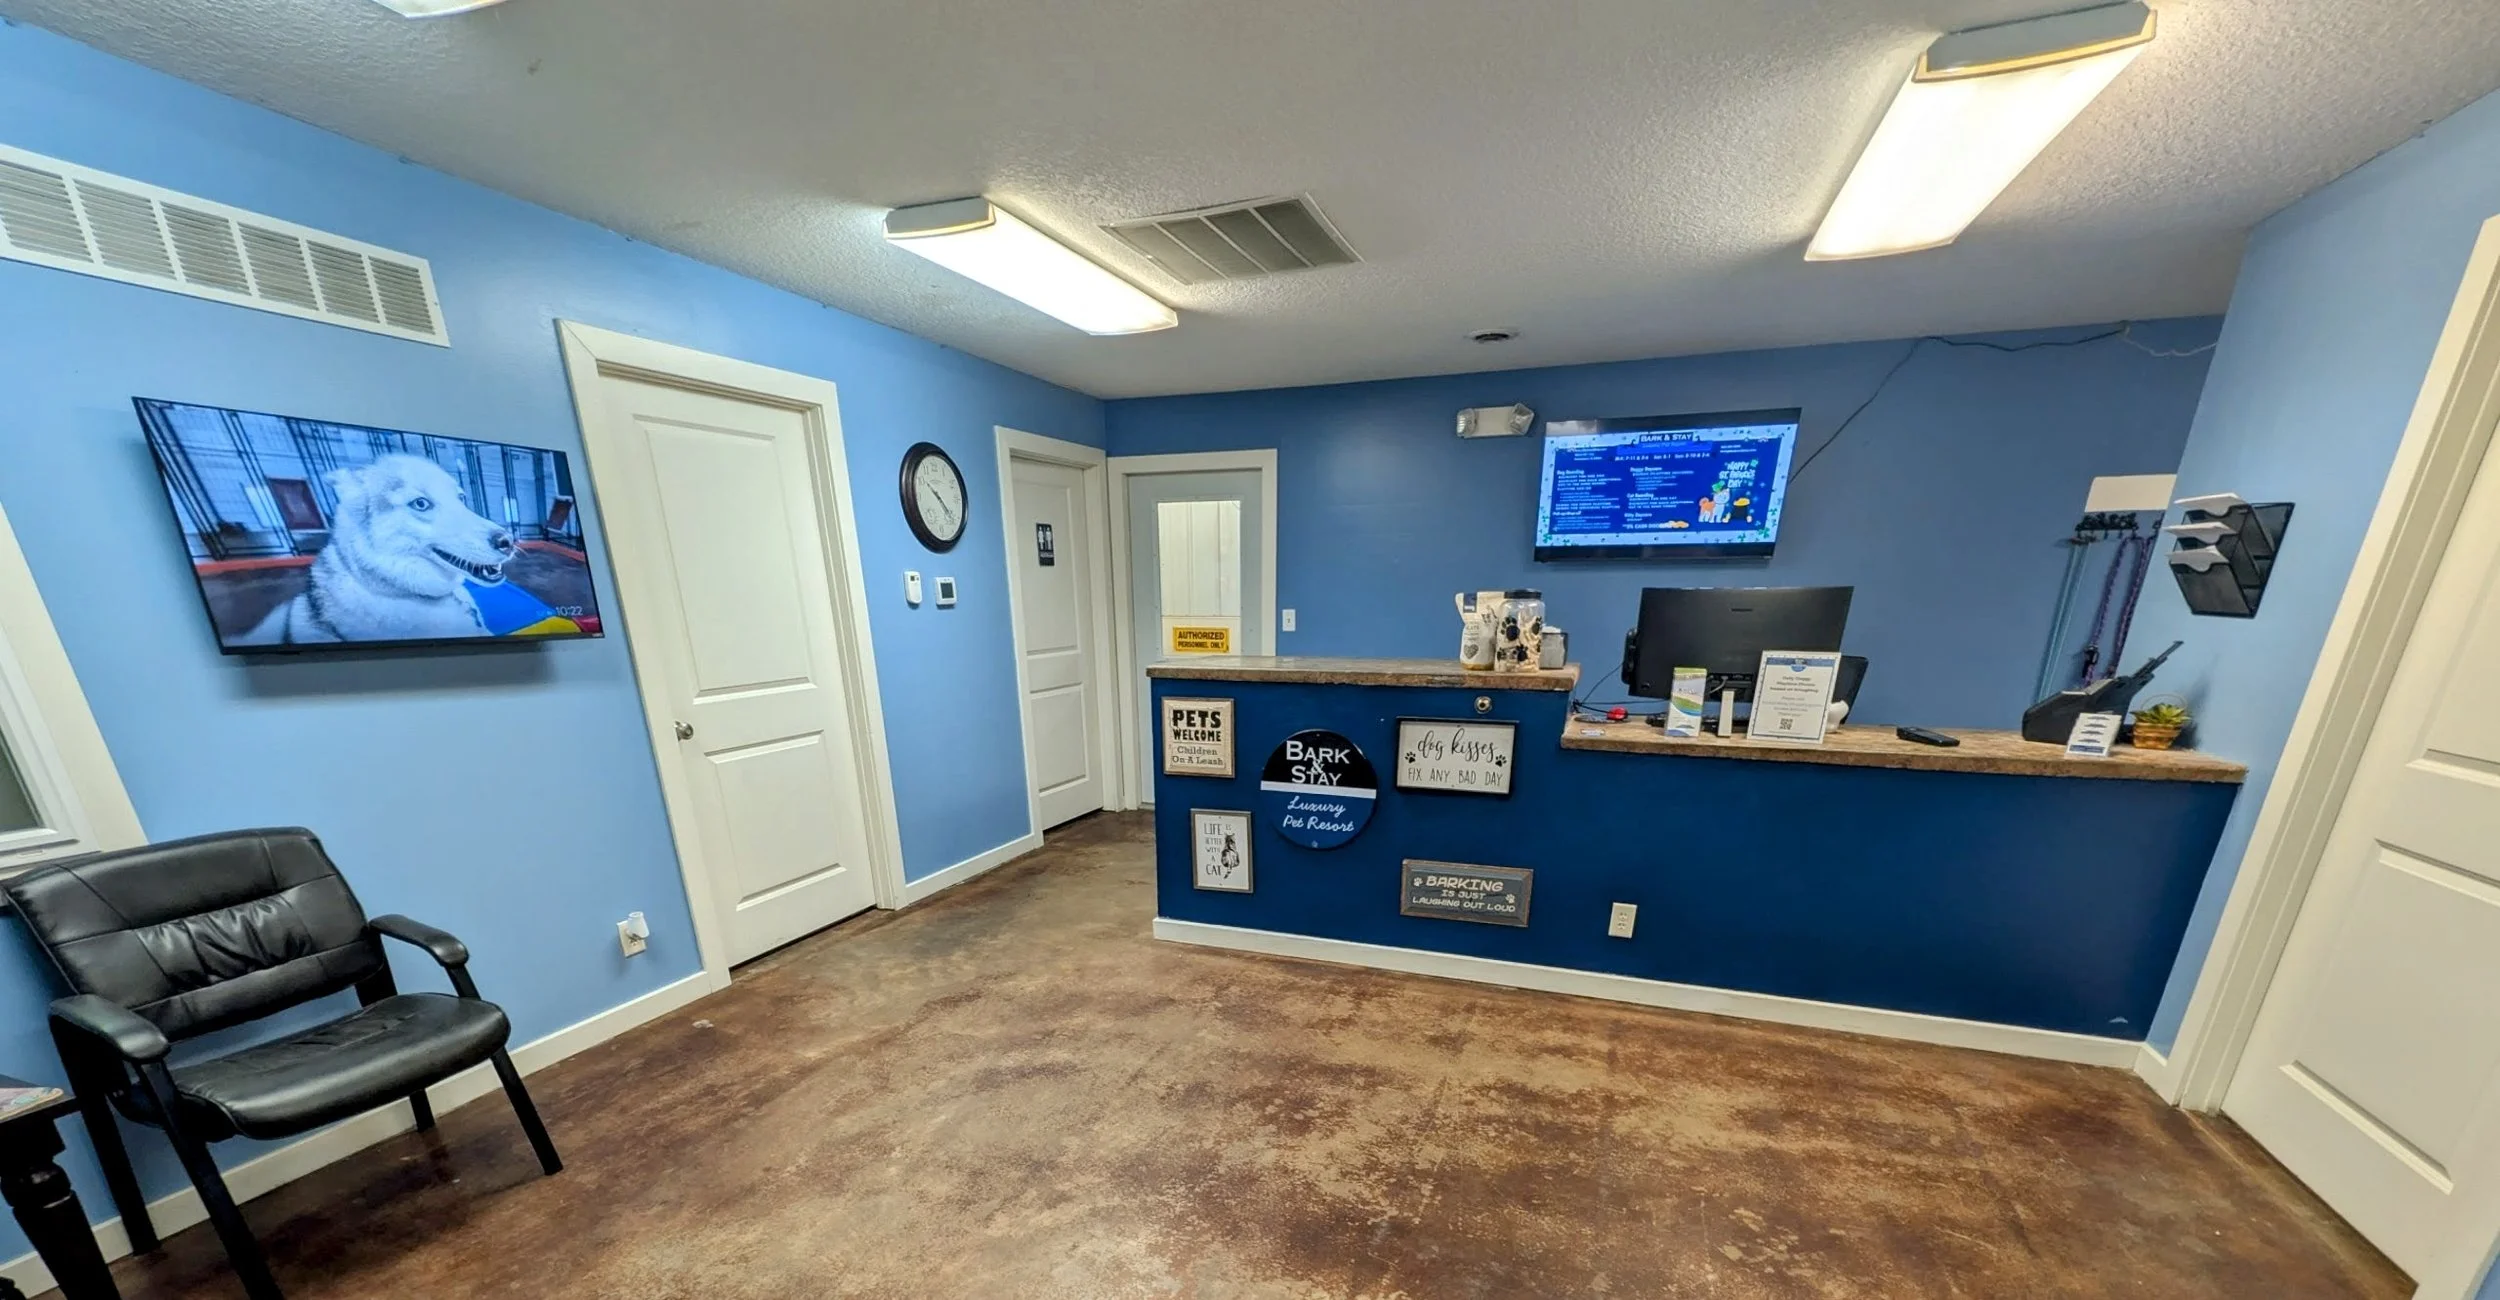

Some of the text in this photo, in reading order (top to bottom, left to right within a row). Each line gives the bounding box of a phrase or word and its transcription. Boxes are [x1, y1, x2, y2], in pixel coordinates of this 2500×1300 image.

[1672, 433, 1692, 441] STAY
[1727, 461, 1749, 471] HAPPY
[555, 605, 584, 617] 10:22
[1178, 631, 1225, 640] AUTHORIZED
[1177, 641, 1225, 649] PERSONNEL ONLY
[1172, 709, 1222, 728] PETS
[1173, 728, 1222, 742] WELCOME
[1177, 746, 1218, 756] Children
[1417, 728, 1497, 764] dog kisses
[1172, 755, 1224, 766] On A Leash
[1311, 759, 1325, 775] &
[1408, 767, 1503, 786] FIX ANY BAD DAY
[1287, 795, 1346, 818] Luxury
[1203, 823, 1223, 836] LIFE
[1282, 814, 1354, 832] Pet Resort
[1205, 864, 1222, 876] CAT
[1426, 875, 1504, 892] BARKING
[1441, 889, 1486, 900] IS JUST
[1412, 896, 1516, 913] LAUGHING OUT LOUD
